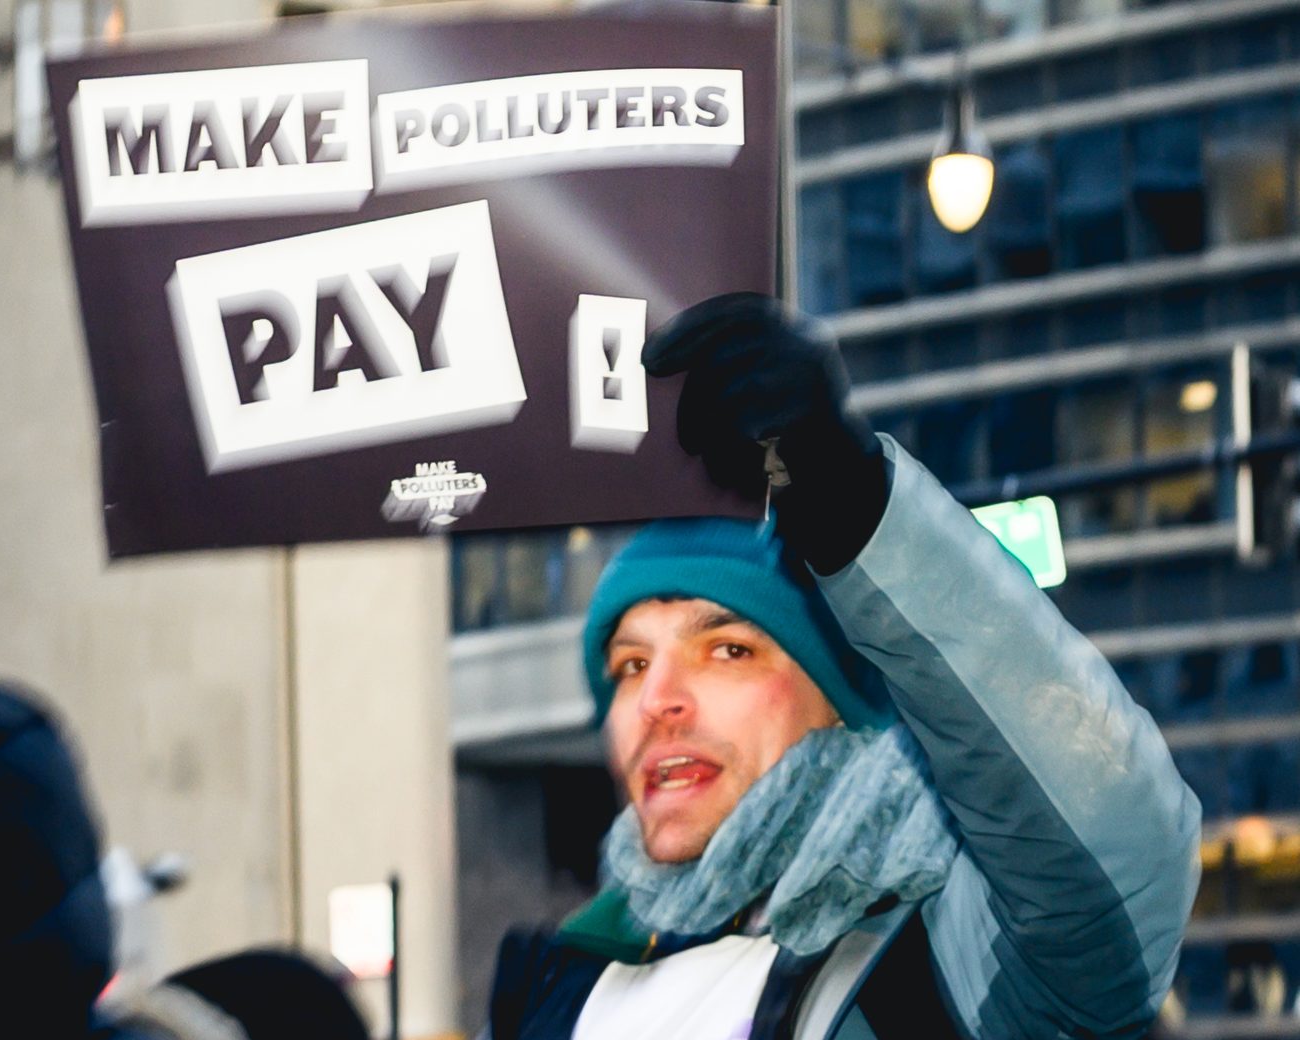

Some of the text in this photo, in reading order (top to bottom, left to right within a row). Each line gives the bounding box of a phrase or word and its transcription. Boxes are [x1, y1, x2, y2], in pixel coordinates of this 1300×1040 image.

[103, 84, 731, 177] MAKE POLLUTERS
[218, 251, 623, 405] PAY !
[400, 477, 479, 495] POLLUTERS
[415, 460, 457, 477] MAKE
